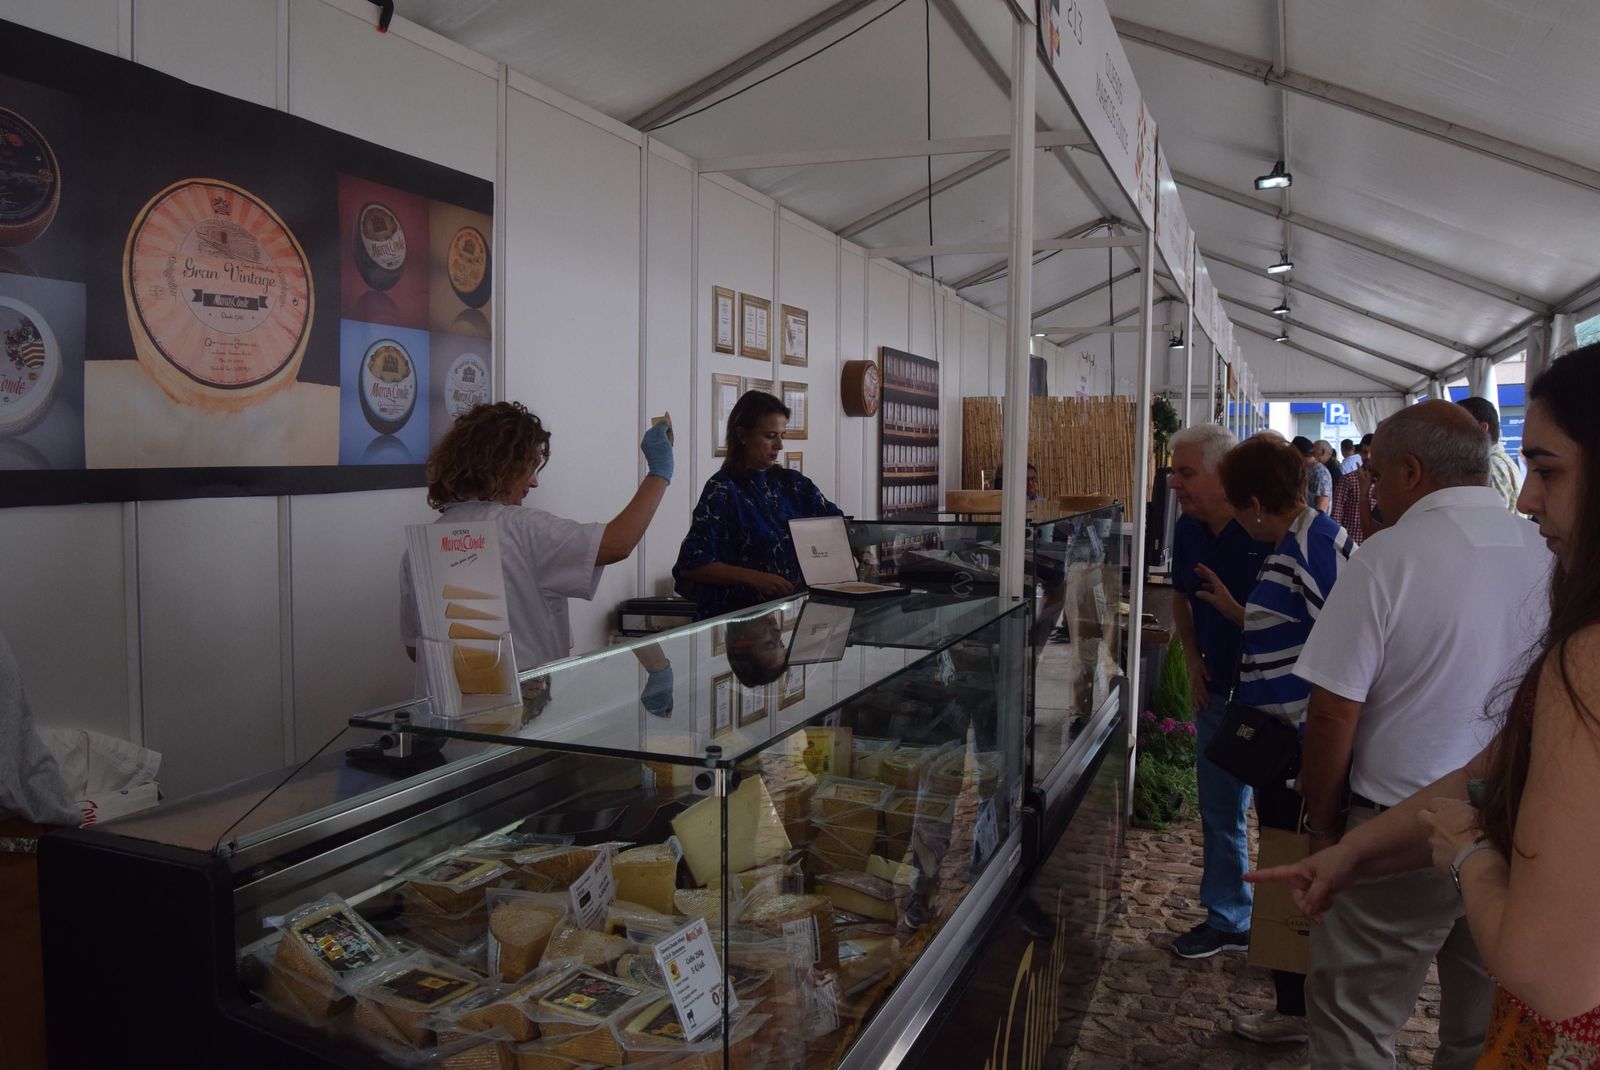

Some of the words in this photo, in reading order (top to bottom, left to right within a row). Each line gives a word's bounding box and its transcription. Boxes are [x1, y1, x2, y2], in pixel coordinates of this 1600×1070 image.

[183, 257, 219, 279] Gran
[223, 262, 276, 294] Vintage
[1330, 403, 1345, 423] P
